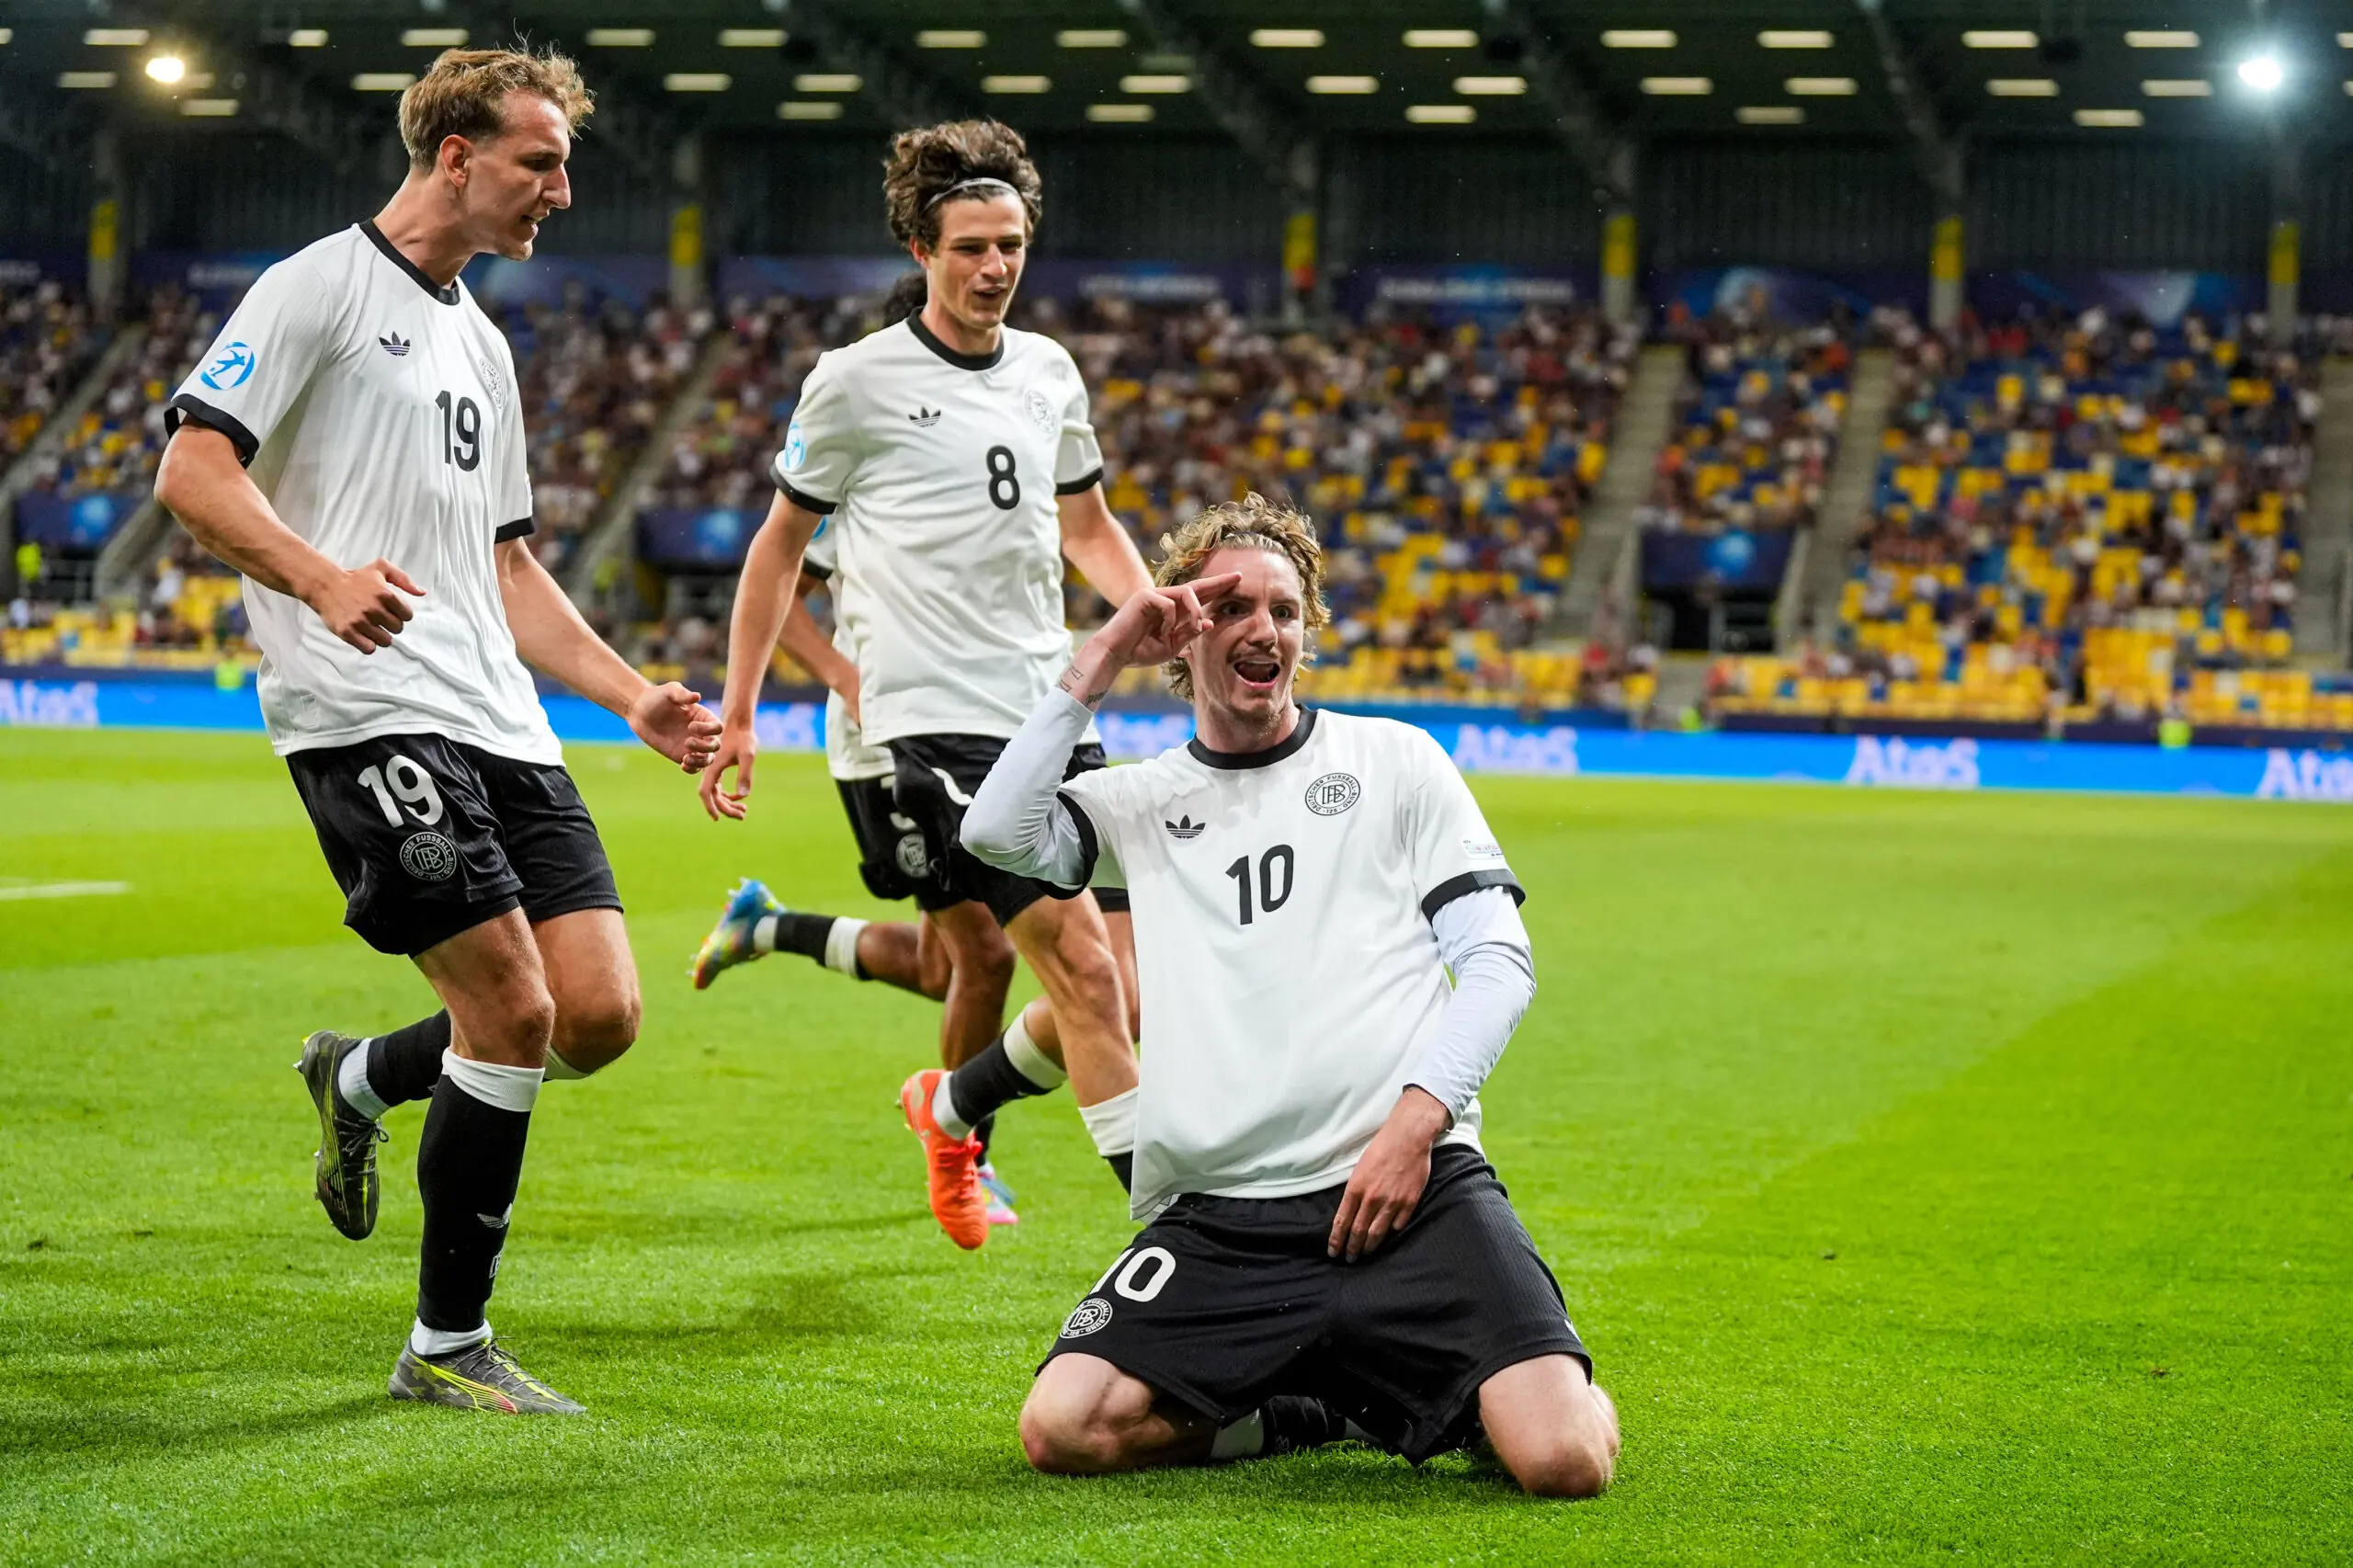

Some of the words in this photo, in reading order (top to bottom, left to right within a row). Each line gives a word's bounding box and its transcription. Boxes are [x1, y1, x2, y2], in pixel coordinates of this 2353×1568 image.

[436, 390, 481, 472] 19
[986, 445, 1020, 510] 8
[357, 755, 444, 829] 19
[1225, 844, 1294, 926] 10
